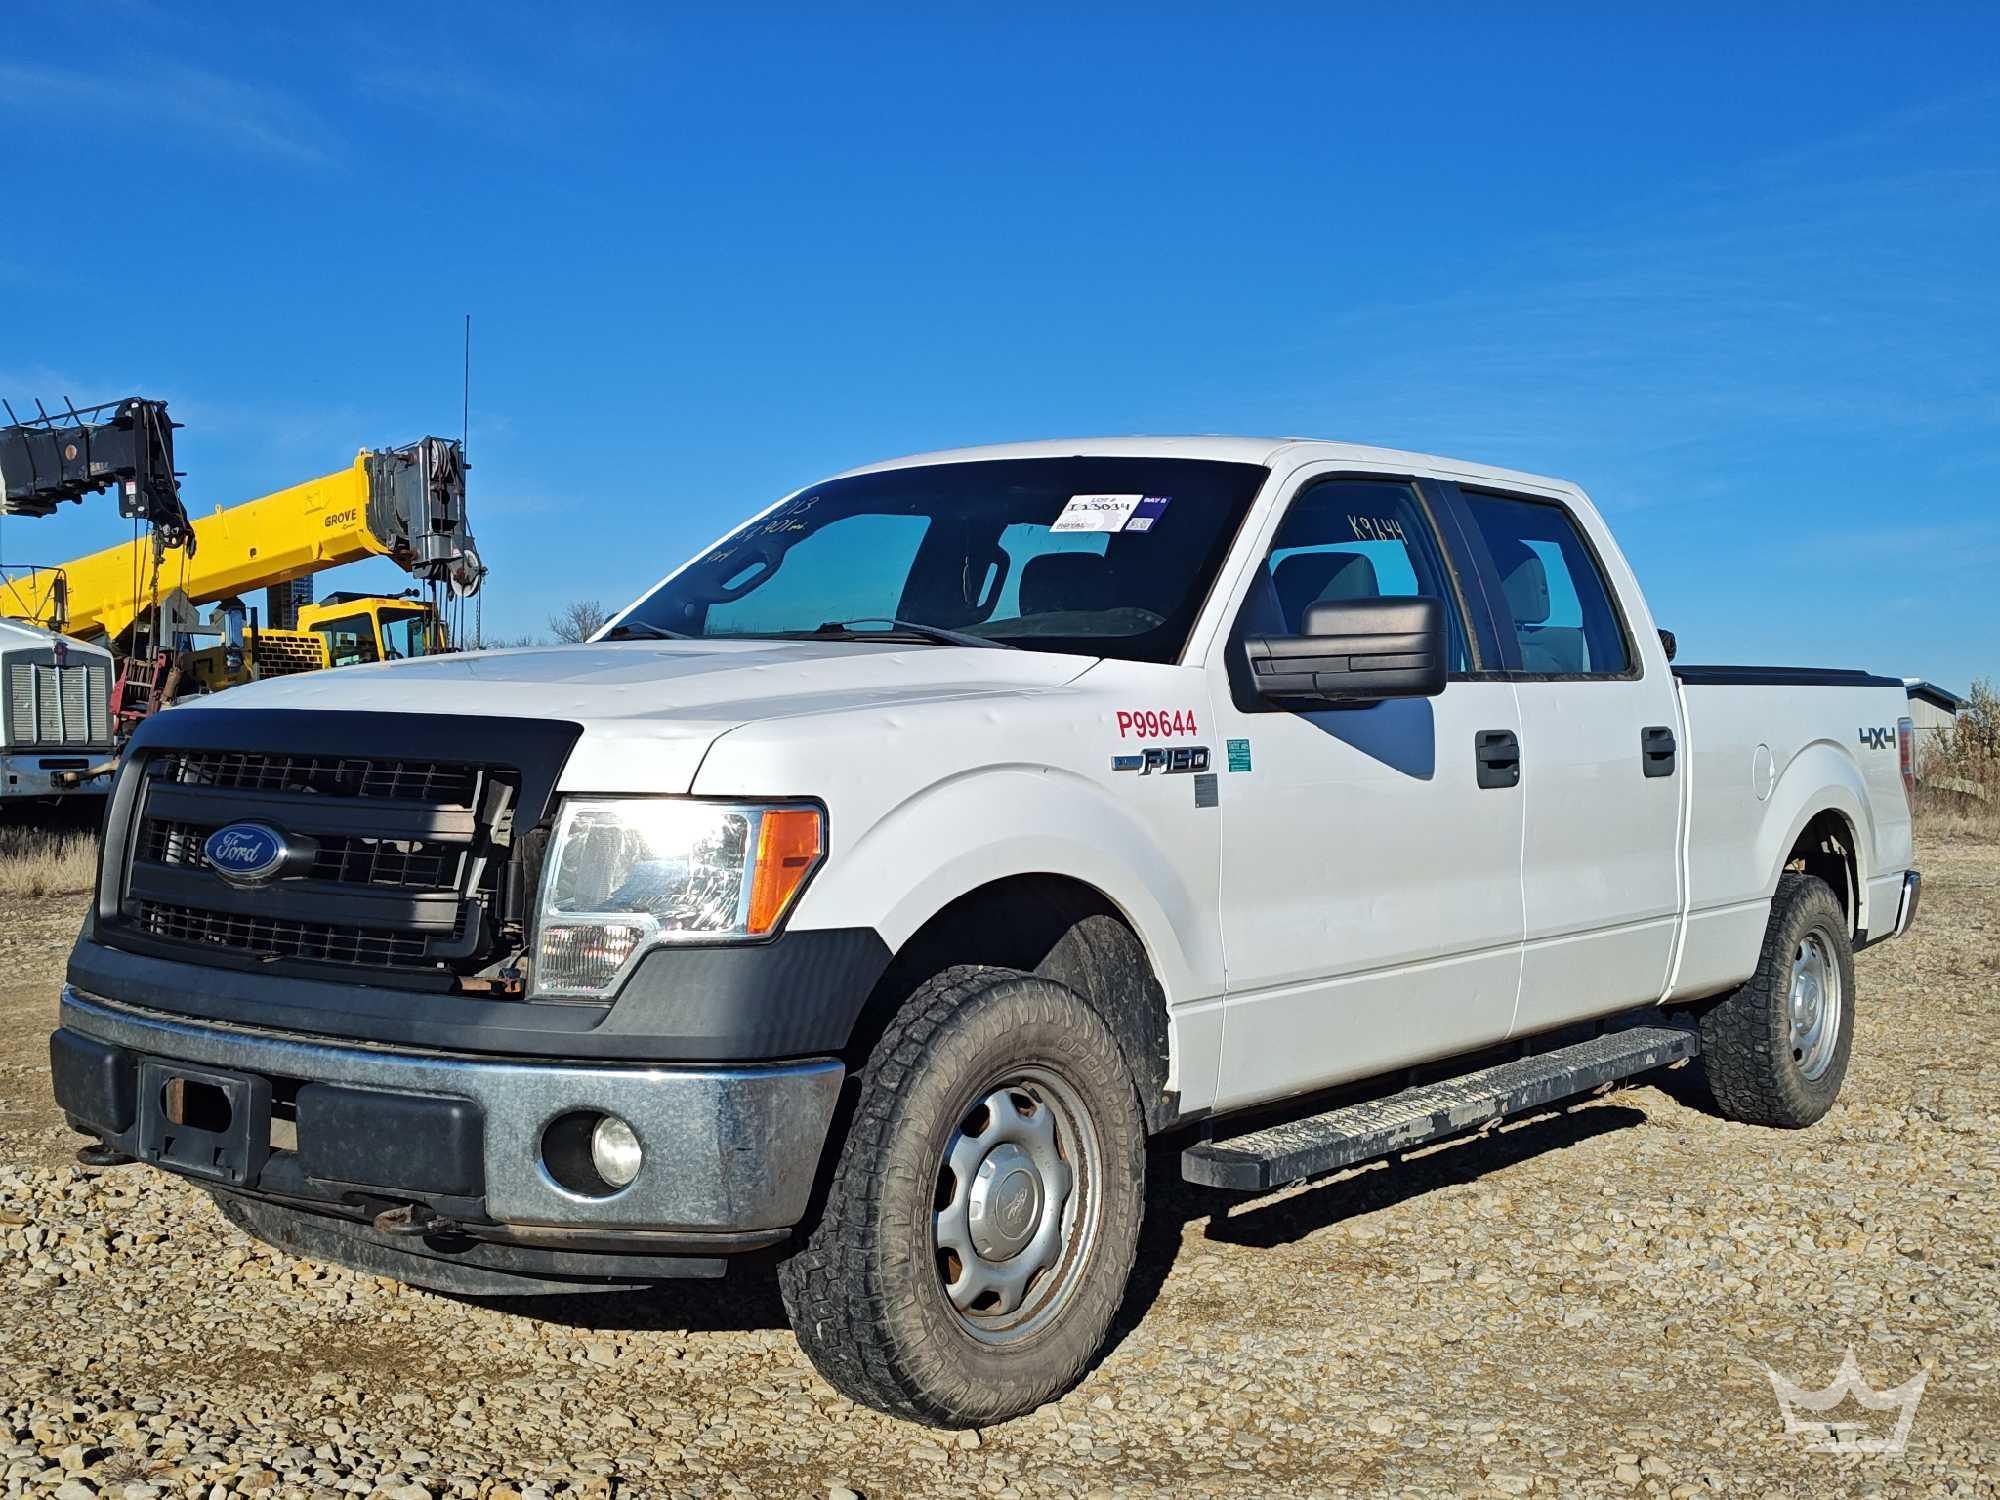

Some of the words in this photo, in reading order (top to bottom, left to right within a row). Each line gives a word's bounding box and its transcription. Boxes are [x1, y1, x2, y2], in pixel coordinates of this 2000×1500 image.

[324, 508, 357, 527] GROVE
[1116, 709, 1197, 738] P99644
[215, 831, 263, 863] Ford
